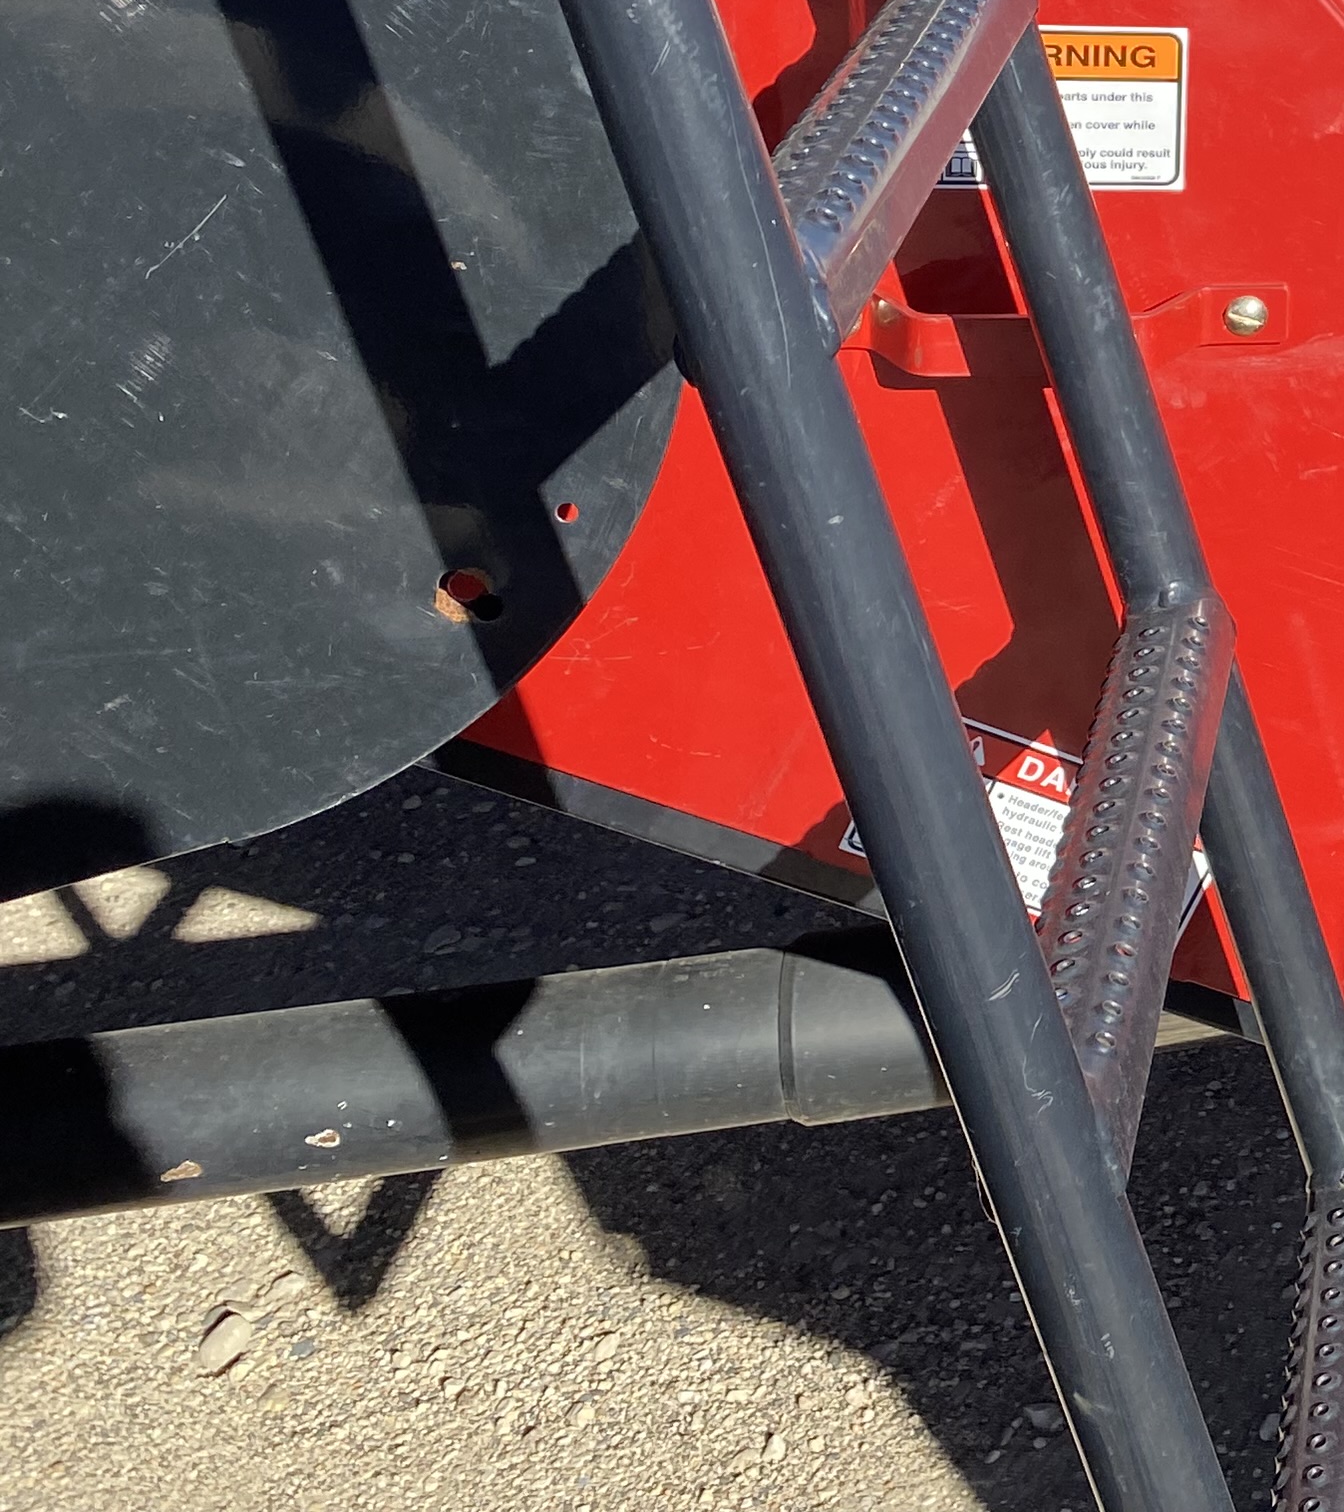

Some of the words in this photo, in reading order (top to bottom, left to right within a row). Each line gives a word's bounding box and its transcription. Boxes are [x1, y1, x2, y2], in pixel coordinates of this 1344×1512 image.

[1045, 44, 1156, 69] RNING
[1091, 92, 1127, 102] under
[1130, 92, 1154, 102] this
[1085, 121, 1120, 130] cover
[1123, 120, 1156, 130] while
[1100, 148, 1134, 158] could
[1136, 148, 1171, 158] result
[1110, 160, 1148, 172] injury.
[1008, 794, 1064, 821] Header/fe
[1002, 806, 1058, 832] hydraulic
[1034, 846, 1052, 859] lift
